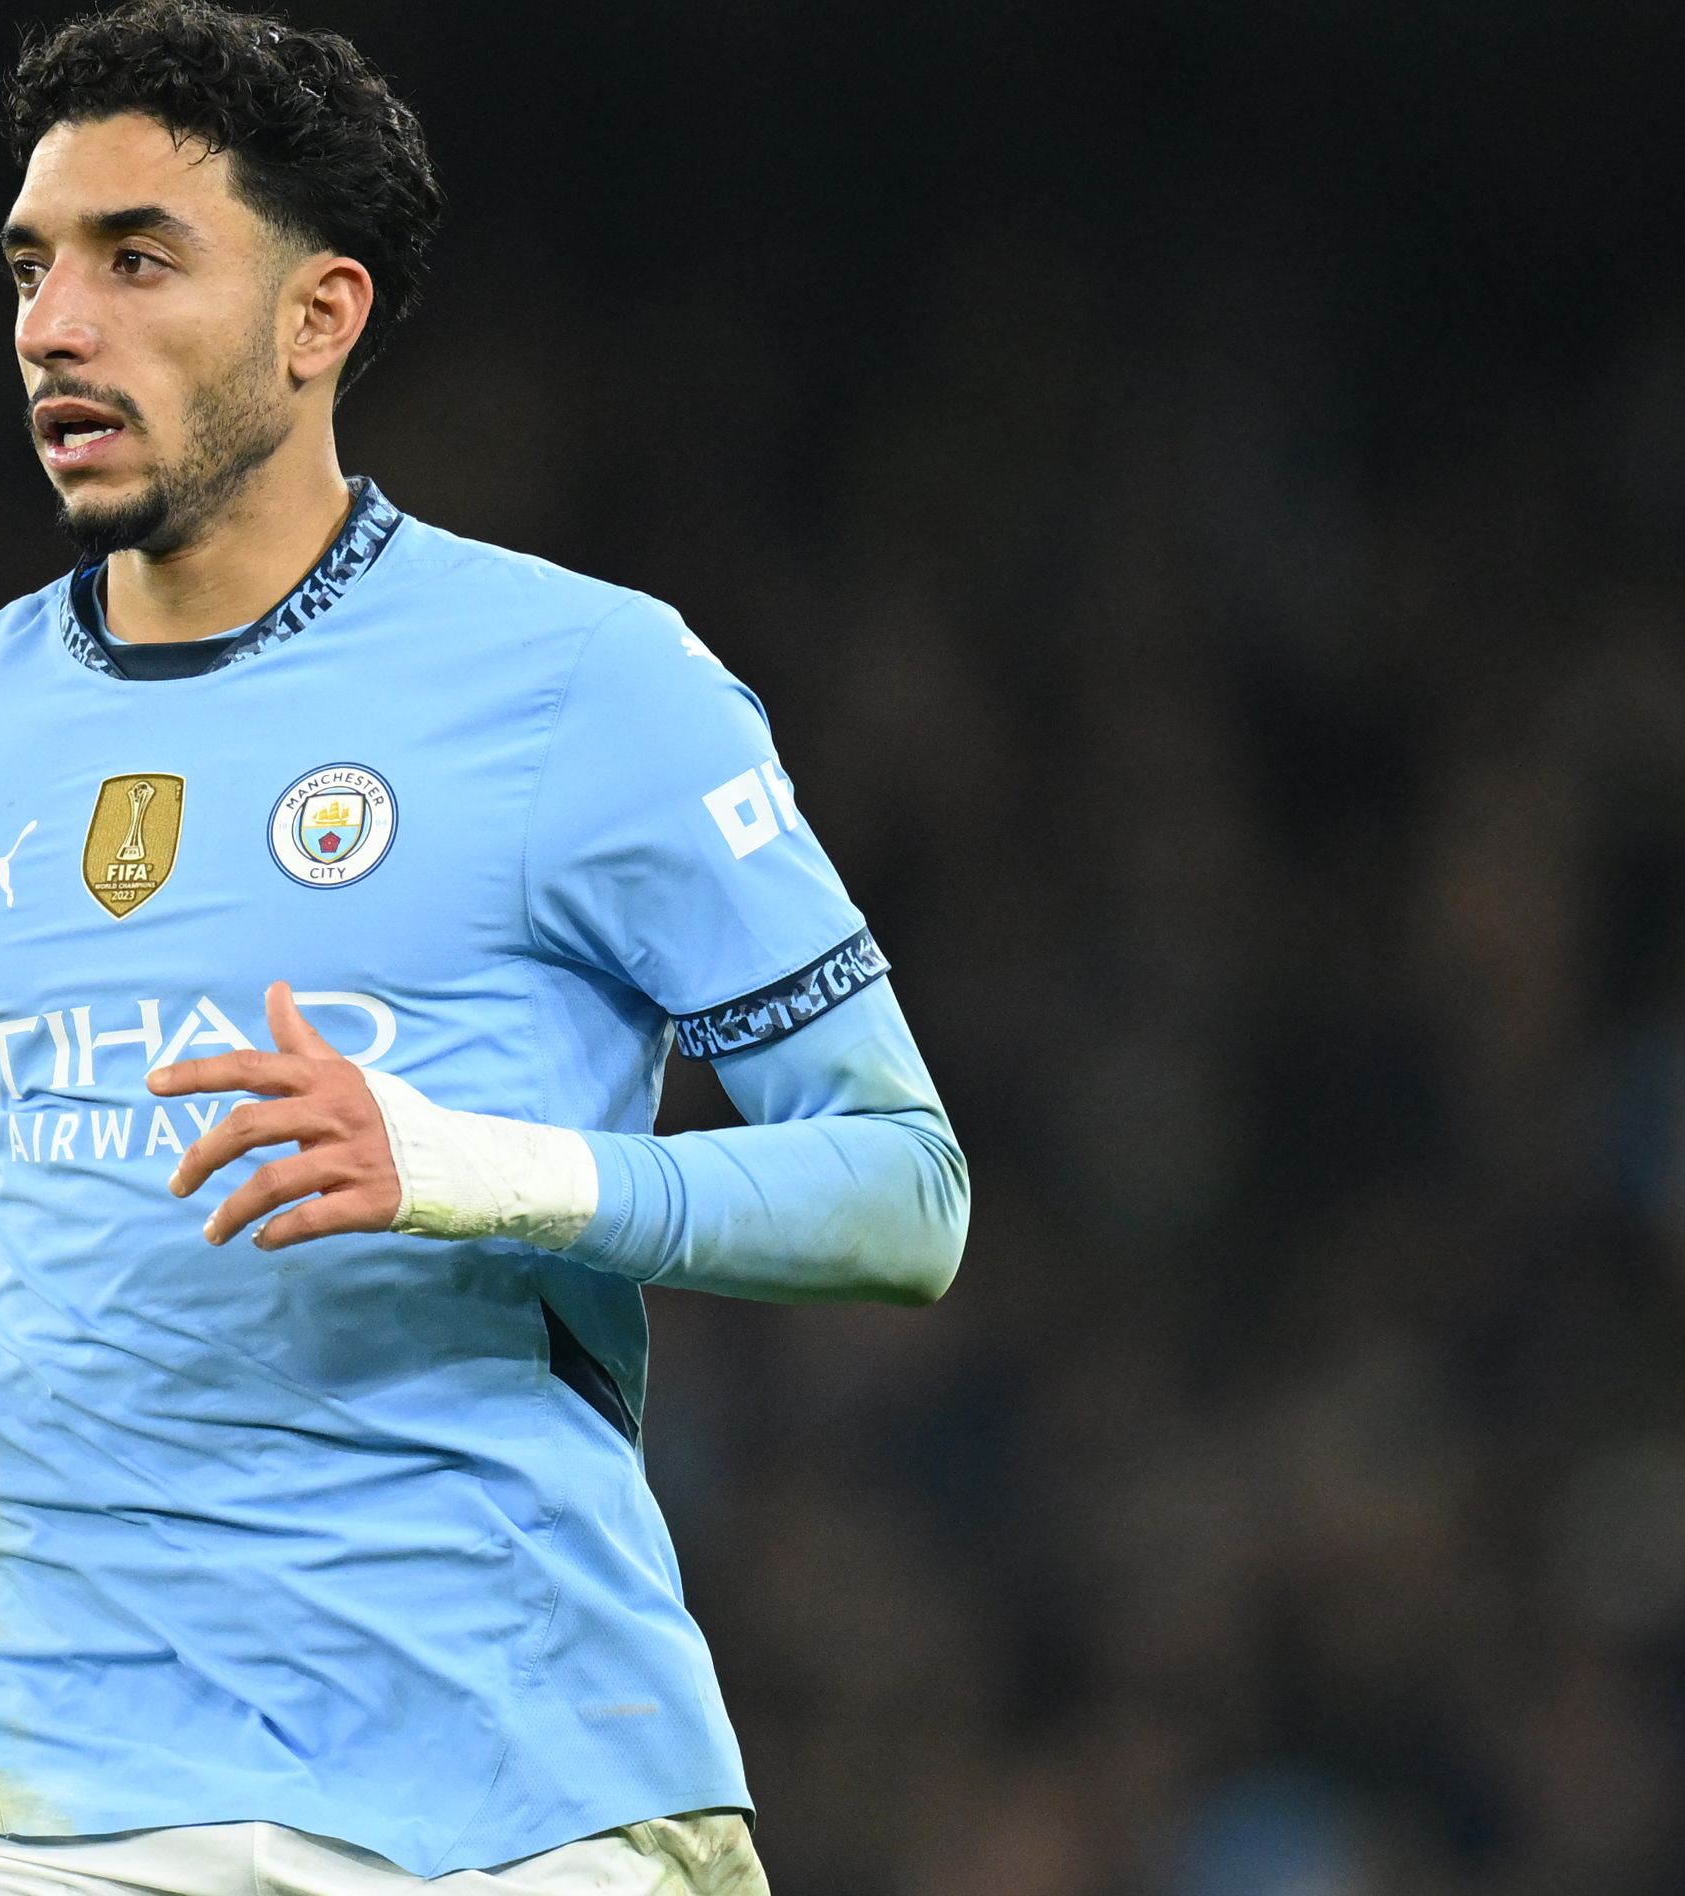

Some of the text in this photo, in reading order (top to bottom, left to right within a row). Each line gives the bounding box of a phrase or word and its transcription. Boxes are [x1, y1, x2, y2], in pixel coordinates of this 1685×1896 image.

[286, 772, 385, 809] MANCHESTER
[309, 867, 347, 880] CITY
[111, 890, 136, 901] 2023
[8, 1097, 261, 1163] AIRWAY
